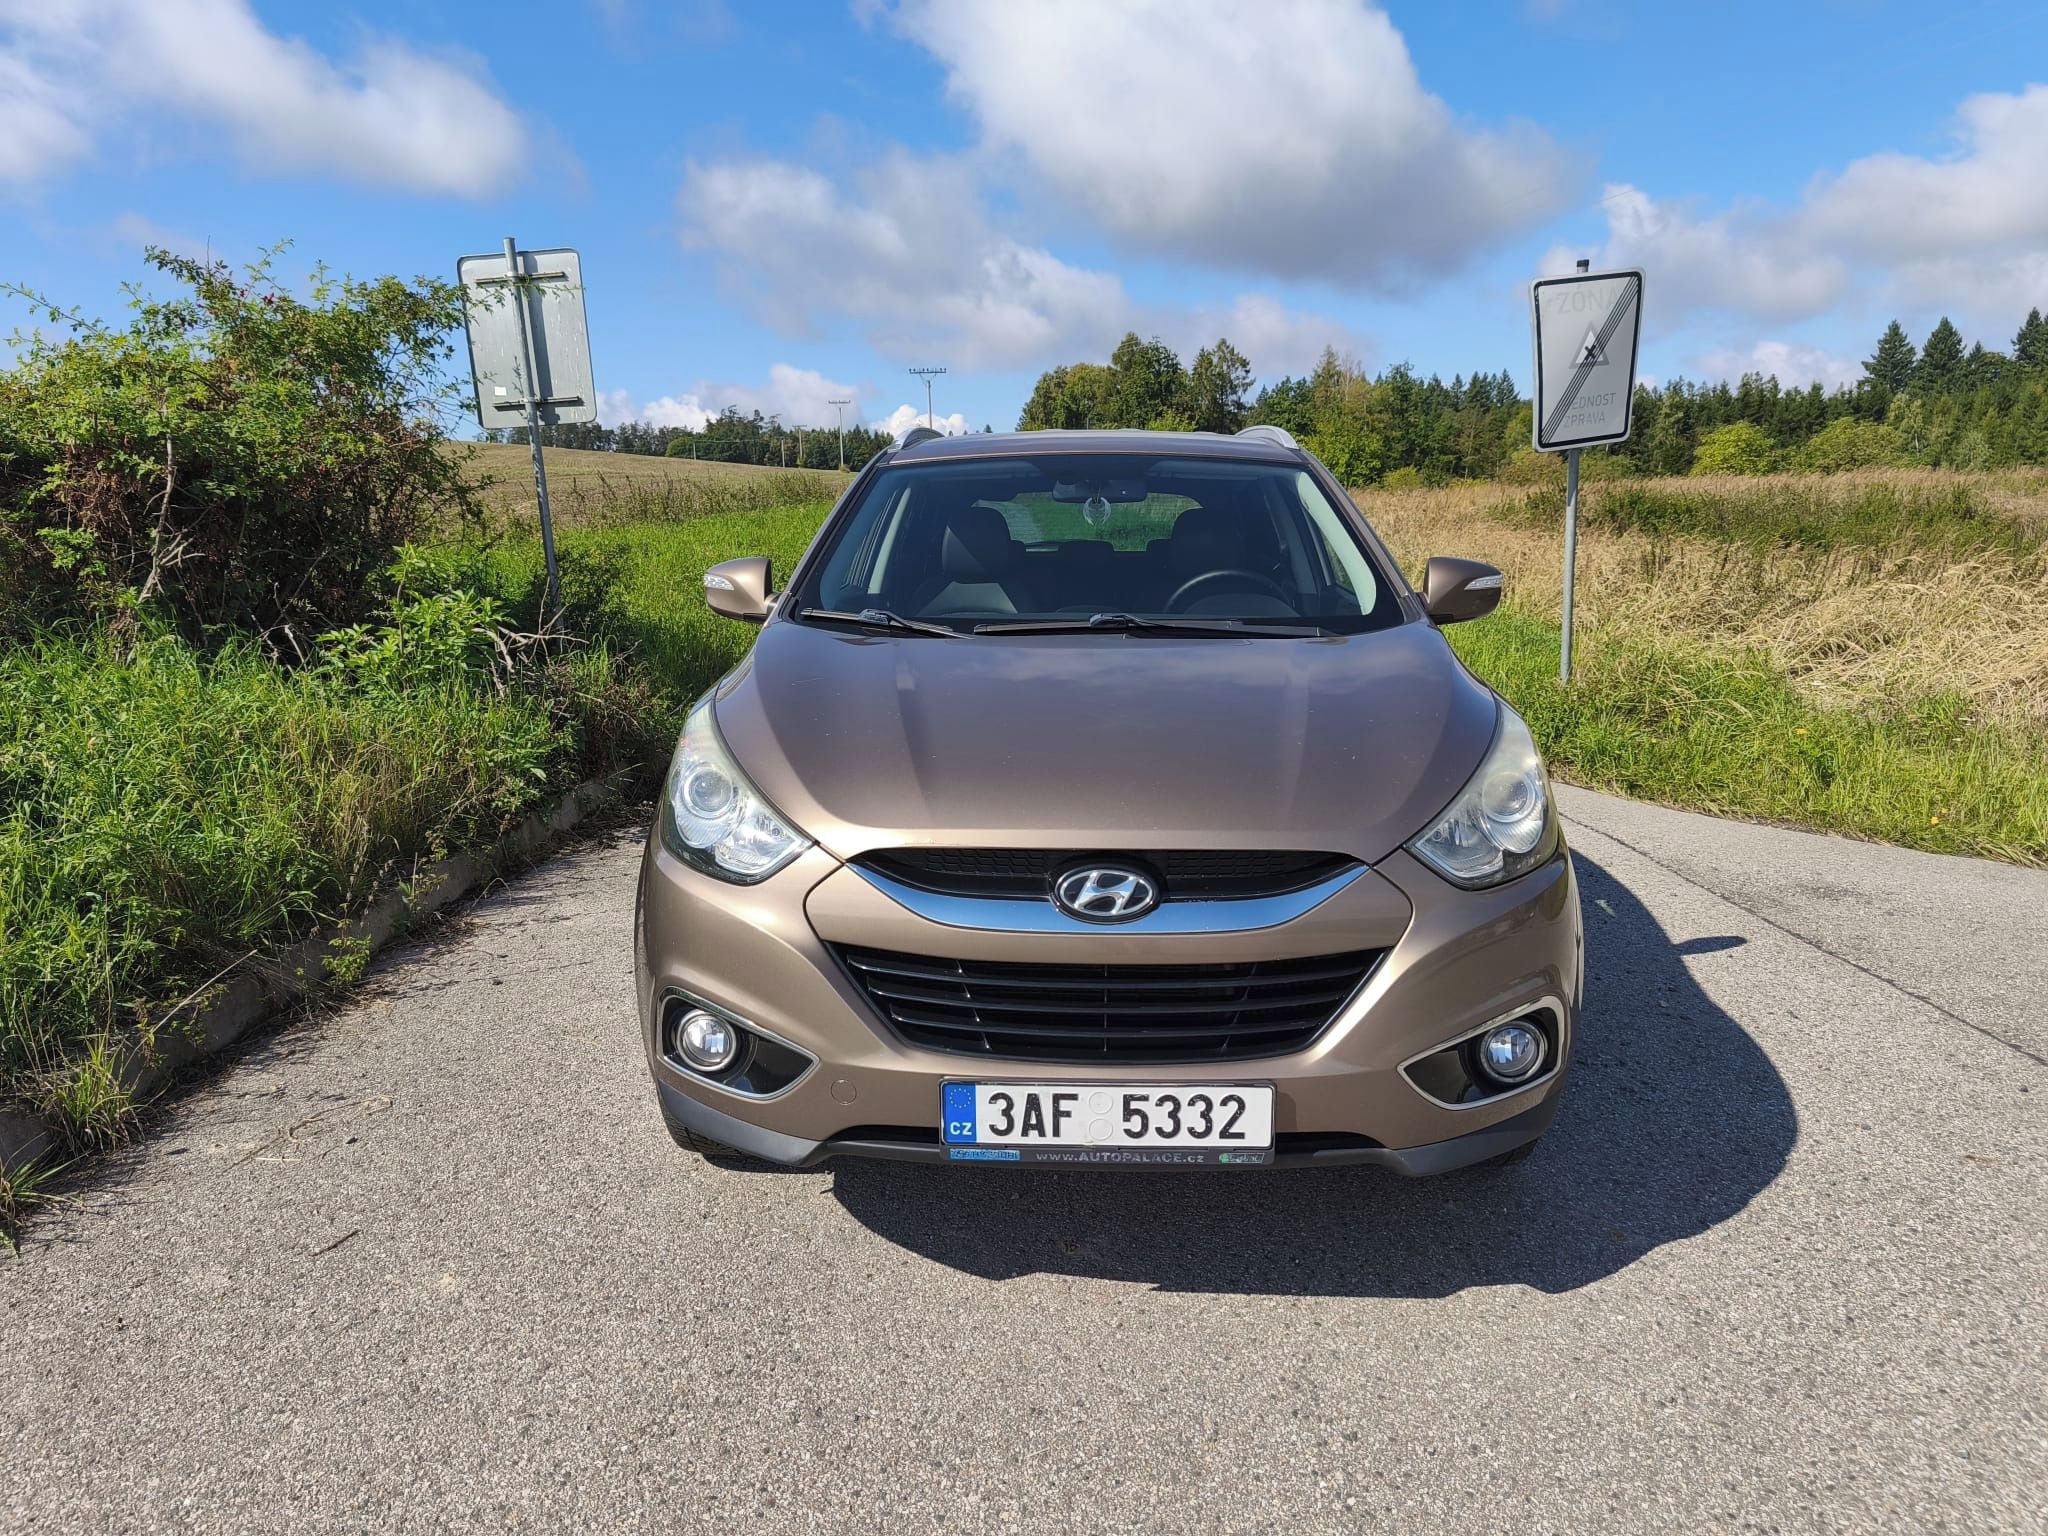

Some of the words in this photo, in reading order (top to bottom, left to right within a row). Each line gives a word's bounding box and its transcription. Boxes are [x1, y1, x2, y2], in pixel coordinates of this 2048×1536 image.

[1563, 411, 1606, 428] ZPRAVA
[988, 1092, 1079, 1138] 3AF
[1122, 1093, 1247, 1140] 5332
[950, 1121, 973, 1136] CZ
